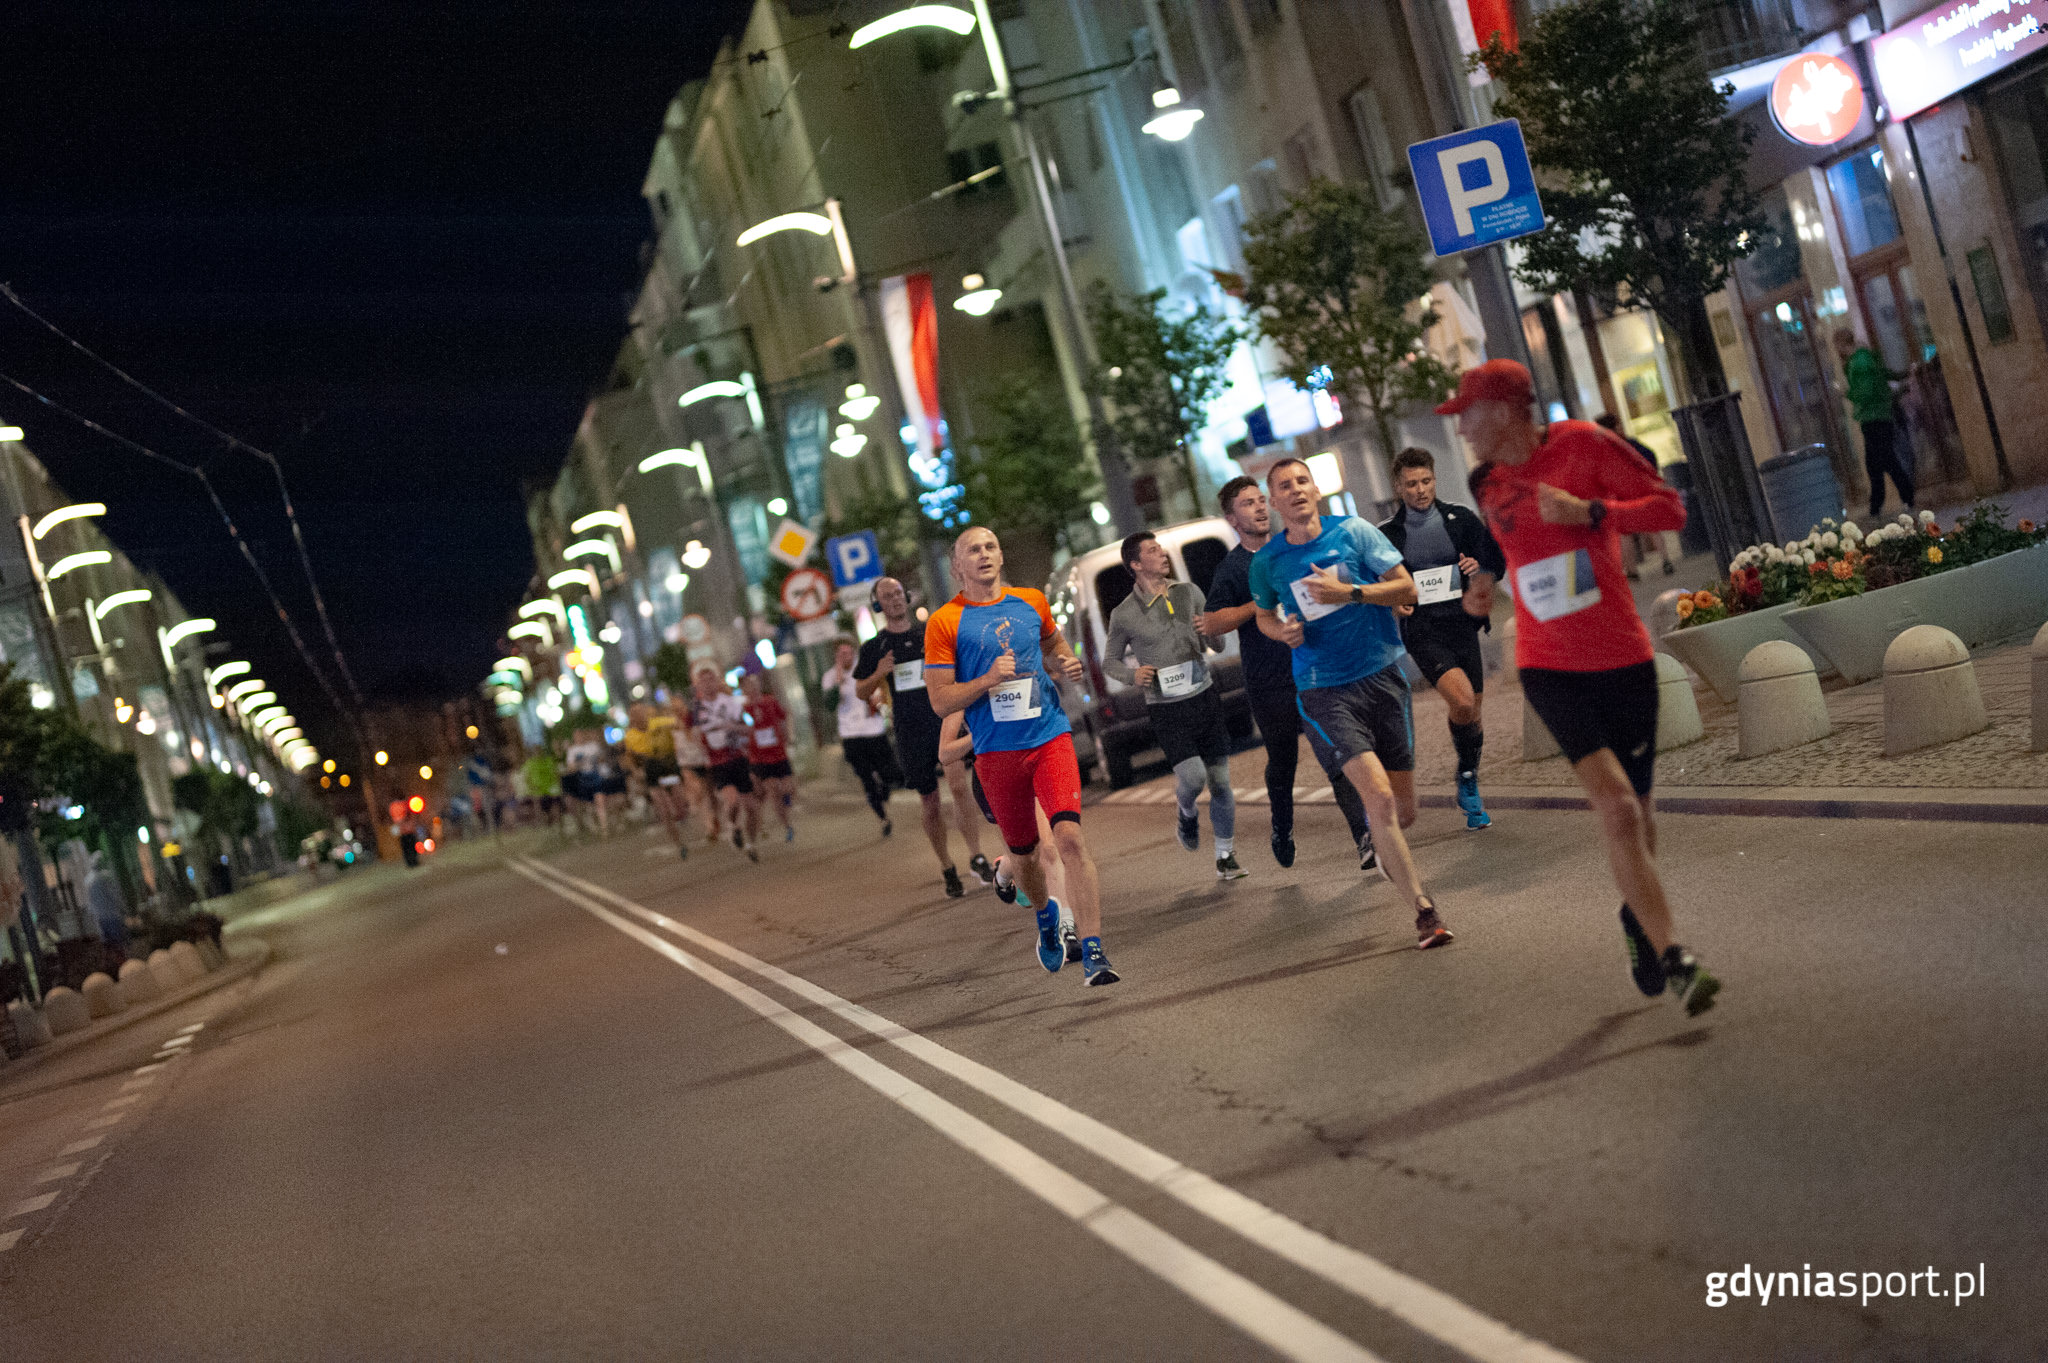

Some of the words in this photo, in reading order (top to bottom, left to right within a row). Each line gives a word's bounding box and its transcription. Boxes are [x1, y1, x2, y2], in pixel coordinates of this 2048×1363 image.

[1436, 139, 1510, 237] P
[838, 538, 870, 580] P
[1420, 577, 1443, 588] 1404
[1163, 672, 1185, 684] 3209
[995, 691, 1022, 703] 2904
